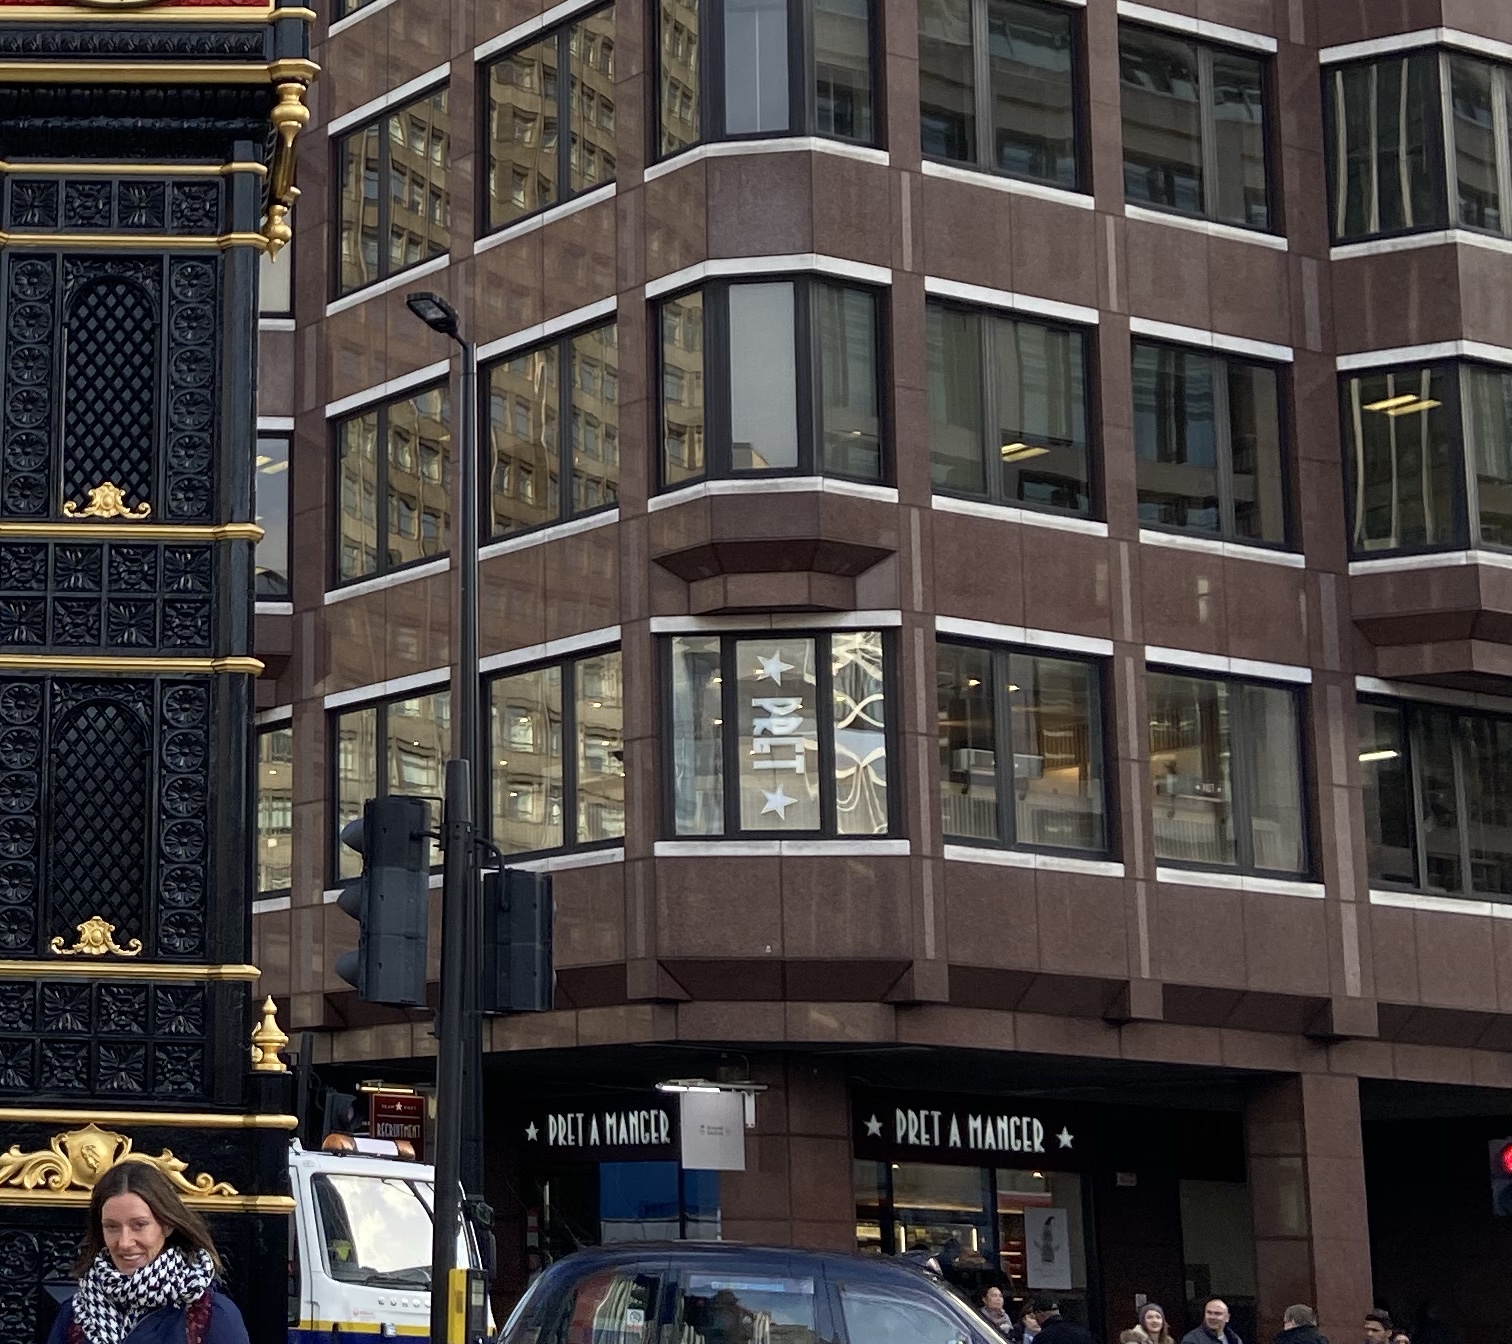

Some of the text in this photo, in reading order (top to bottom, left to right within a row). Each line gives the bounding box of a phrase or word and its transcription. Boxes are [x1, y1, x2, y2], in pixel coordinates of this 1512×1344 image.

[752, 697, 804, 773] PRET
[376, 1122, 420, 1138] RECRUITMENT
[548, 1109, 670, 1146] PRET A MANGER
[895, 1108, 1045, 1153] PRET A MANGER
